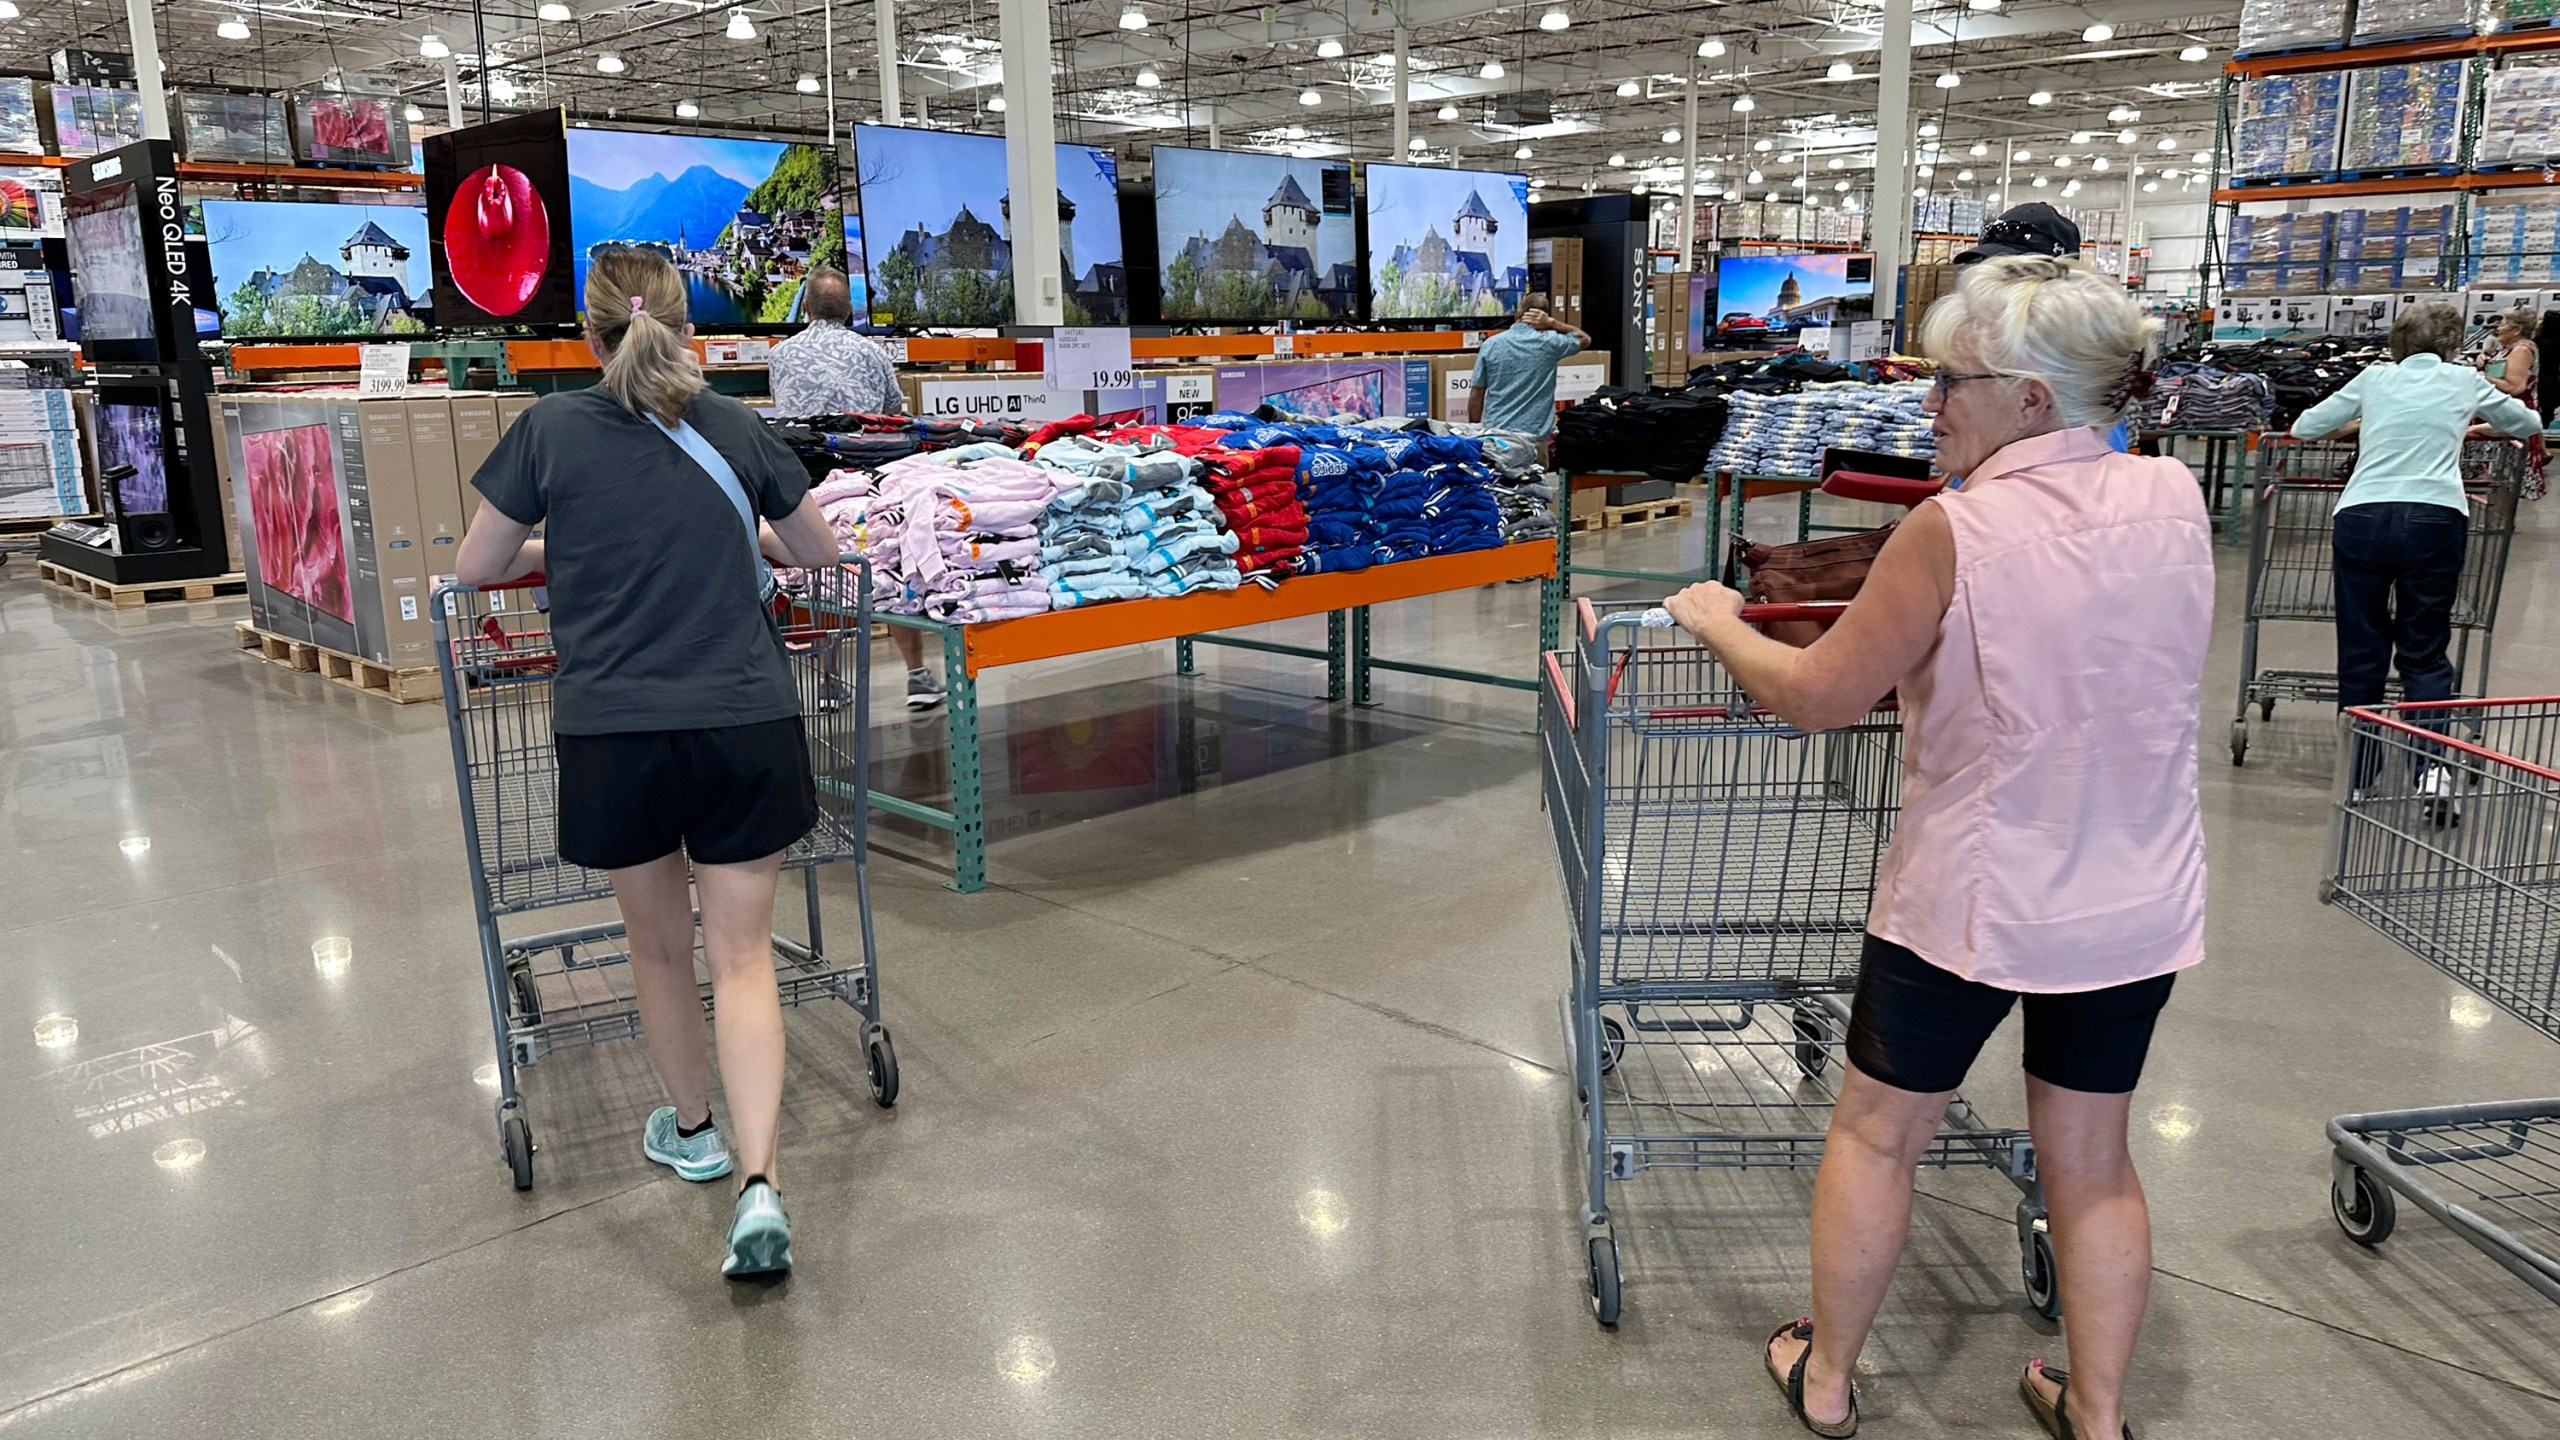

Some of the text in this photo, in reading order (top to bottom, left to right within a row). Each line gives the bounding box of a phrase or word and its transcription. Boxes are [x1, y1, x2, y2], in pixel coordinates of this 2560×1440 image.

[155, 176, 192, 306] Neo QLED 4K
[0, 261, 18, 269] RED
[1632, 247, 1644, 330] SONY
[1092, 370, 1131, 388] 19.99
[1220, 371, 1246, 379] SAMSUNG
[370, 379, 405, 393] 3199.99
[1179, 389, 1200, 399] NEW
[935, 394, 1046, 415] LG UHD AI ThinQ
[1311, 462, 1348, 478] adidas
